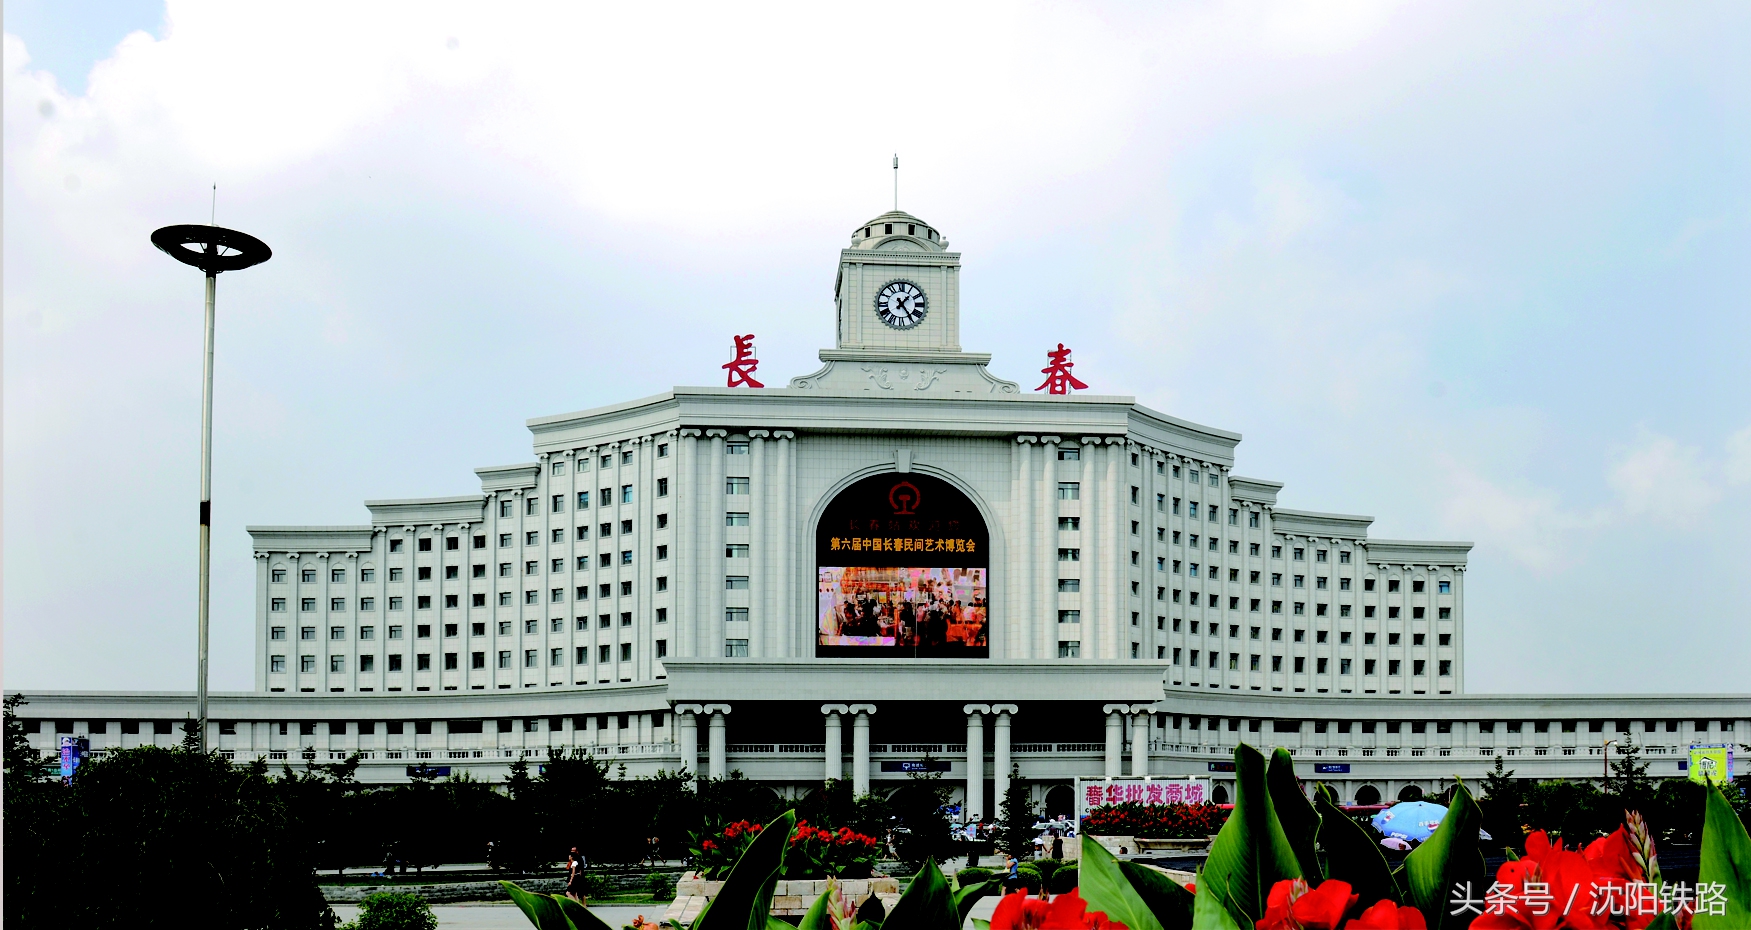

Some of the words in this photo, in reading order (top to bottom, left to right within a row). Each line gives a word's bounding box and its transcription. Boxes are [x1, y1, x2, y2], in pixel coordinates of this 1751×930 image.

[722, 334, 764, 389] 長
[1034, 343, 1089, 395] 春
[830, 537, 976, 553] 第六届中国长春民间艺术博览会
[1085, 783, 1204, 806] 春华批发商城
